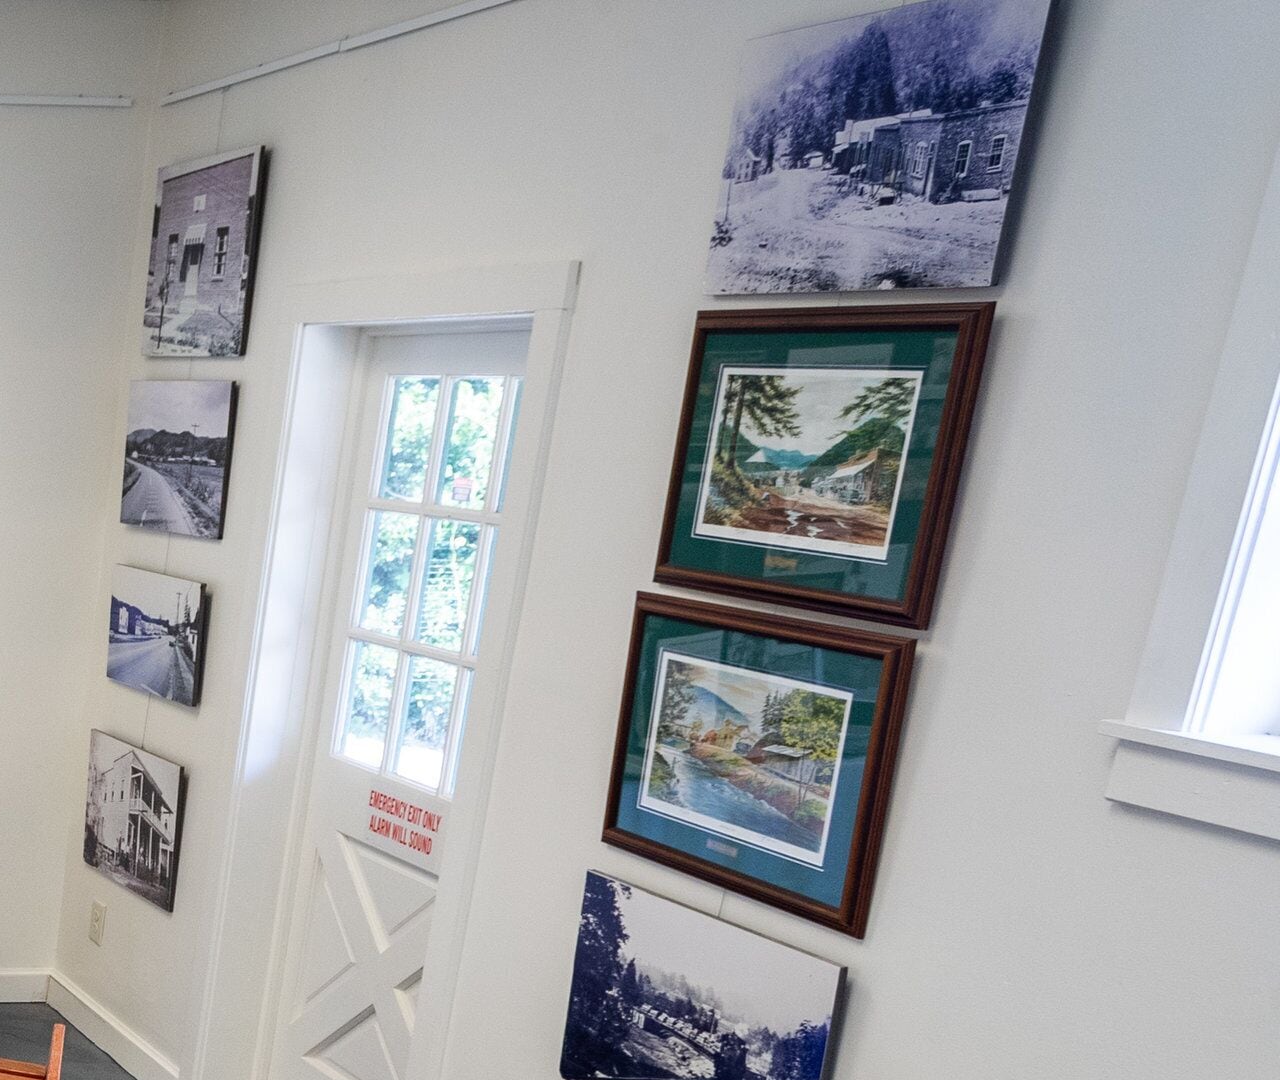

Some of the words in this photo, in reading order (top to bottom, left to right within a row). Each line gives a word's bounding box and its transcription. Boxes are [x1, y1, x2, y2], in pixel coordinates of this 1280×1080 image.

[368, 790, 408, 820] EMERGENCY
[407, 801, 424, 825] EXIT
[422, 807, 442, 832] ONLY
[369, 815, 390, 838] ALARM
[390, 822, 406, 845] WILL
[408, 829, 432, 855] SOUND
